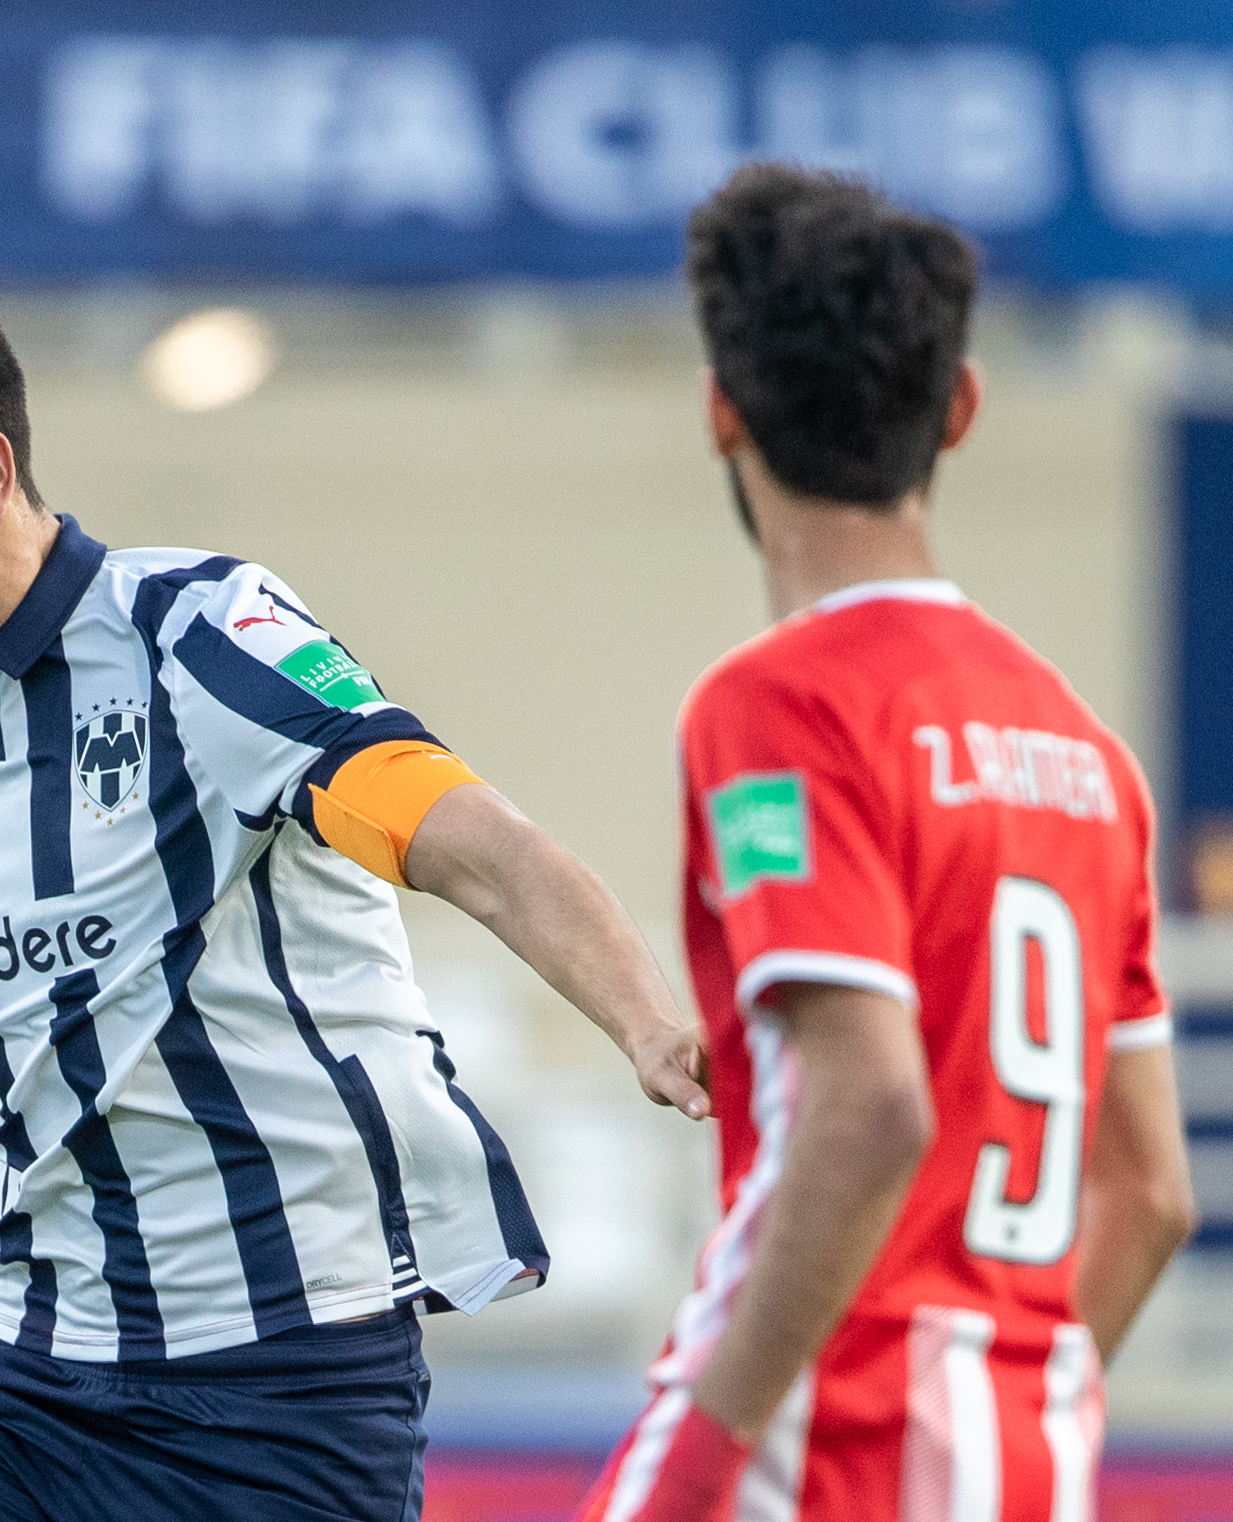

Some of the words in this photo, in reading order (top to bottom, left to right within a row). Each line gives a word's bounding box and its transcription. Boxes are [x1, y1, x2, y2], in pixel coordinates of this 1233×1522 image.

[308, 661, 357, 689] FOOTBAL
[963, 873, 1085, 1265] 9
[306, 1273, 343, 1289] DRYCELL
